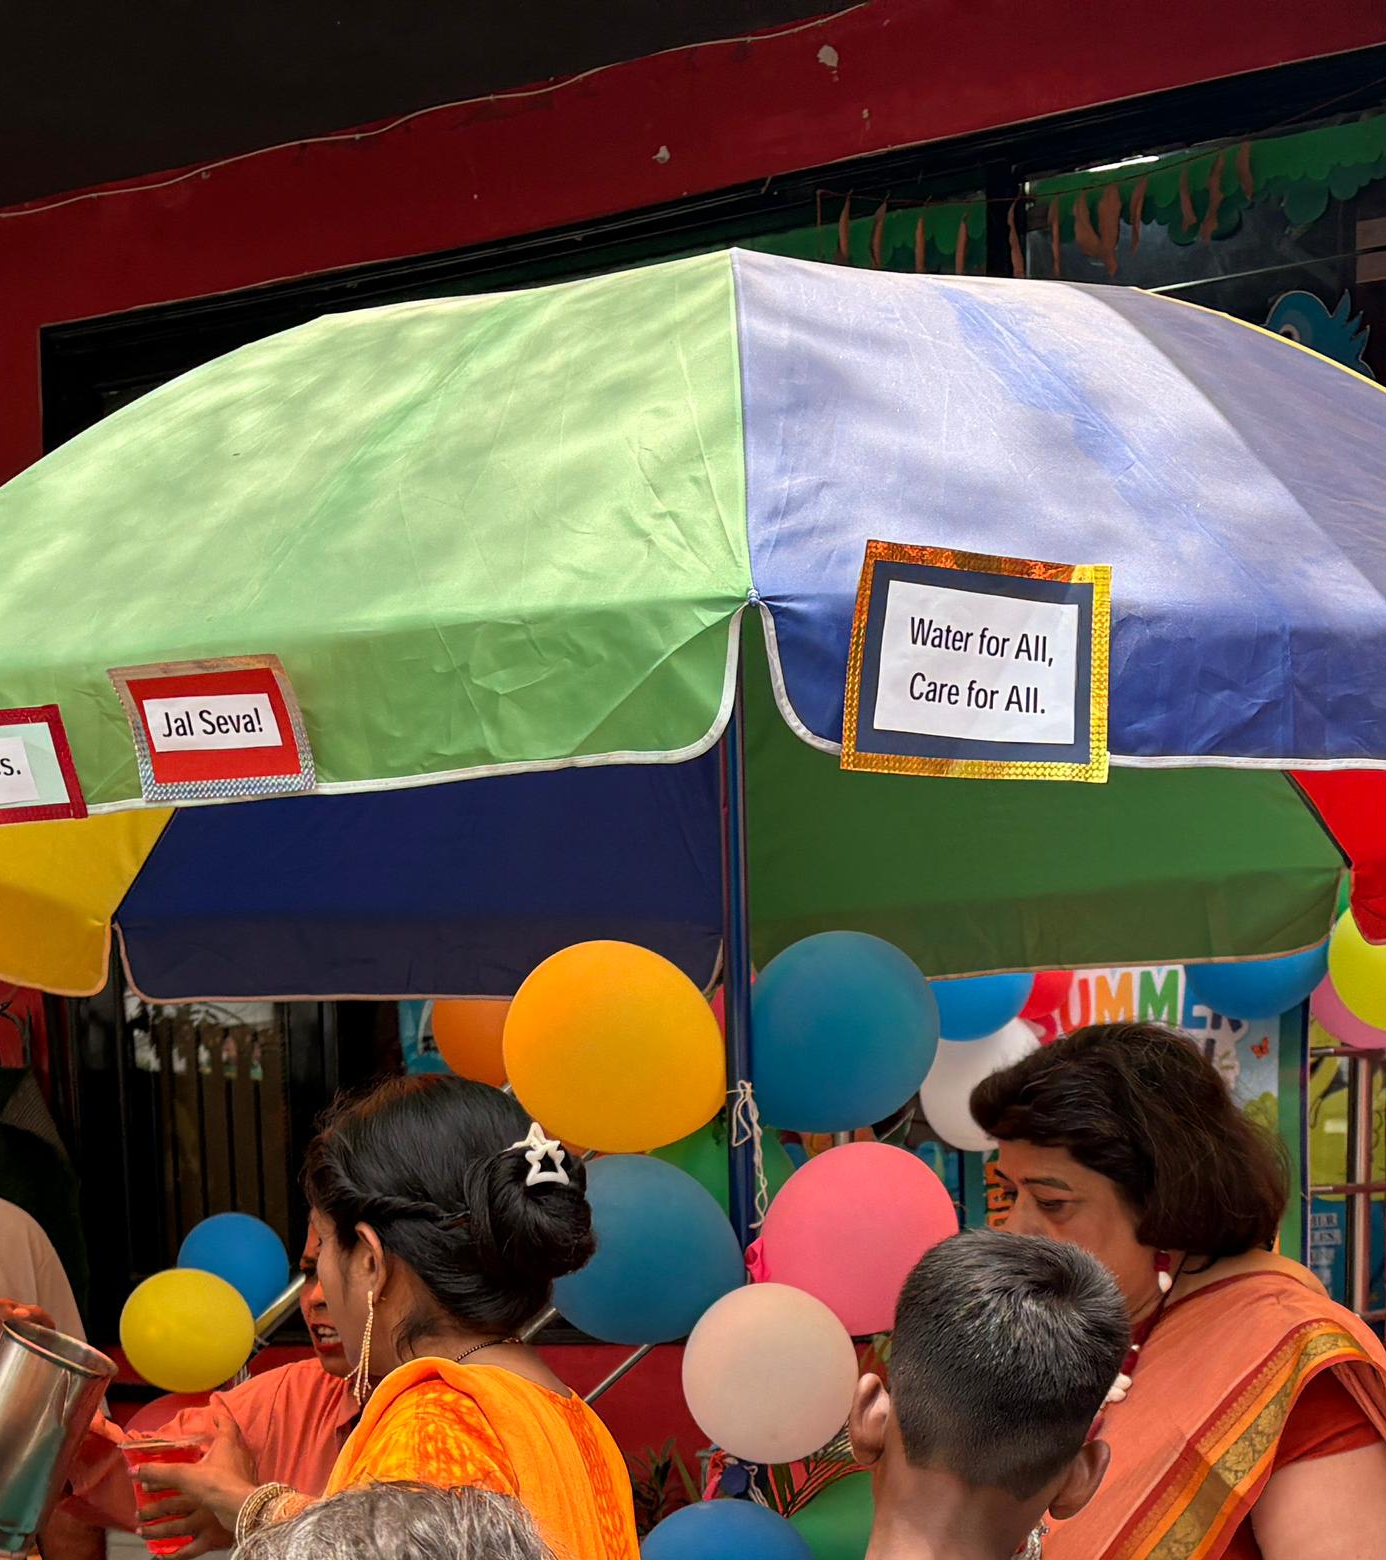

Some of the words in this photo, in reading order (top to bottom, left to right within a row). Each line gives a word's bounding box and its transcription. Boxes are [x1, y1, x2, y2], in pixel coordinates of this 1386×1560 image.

[910, 616, 973, 653] Water
[979, 627, 1010, 658] for
[1014, 632, 1055, 667] All,
[909, 672, 959, 706] Care
[966, 679, 999, 710] for
[1004, 685, 1046, 715] All.
[161, 711, 195, 739] Jal
[198, 707, 265, 737] Seva!
